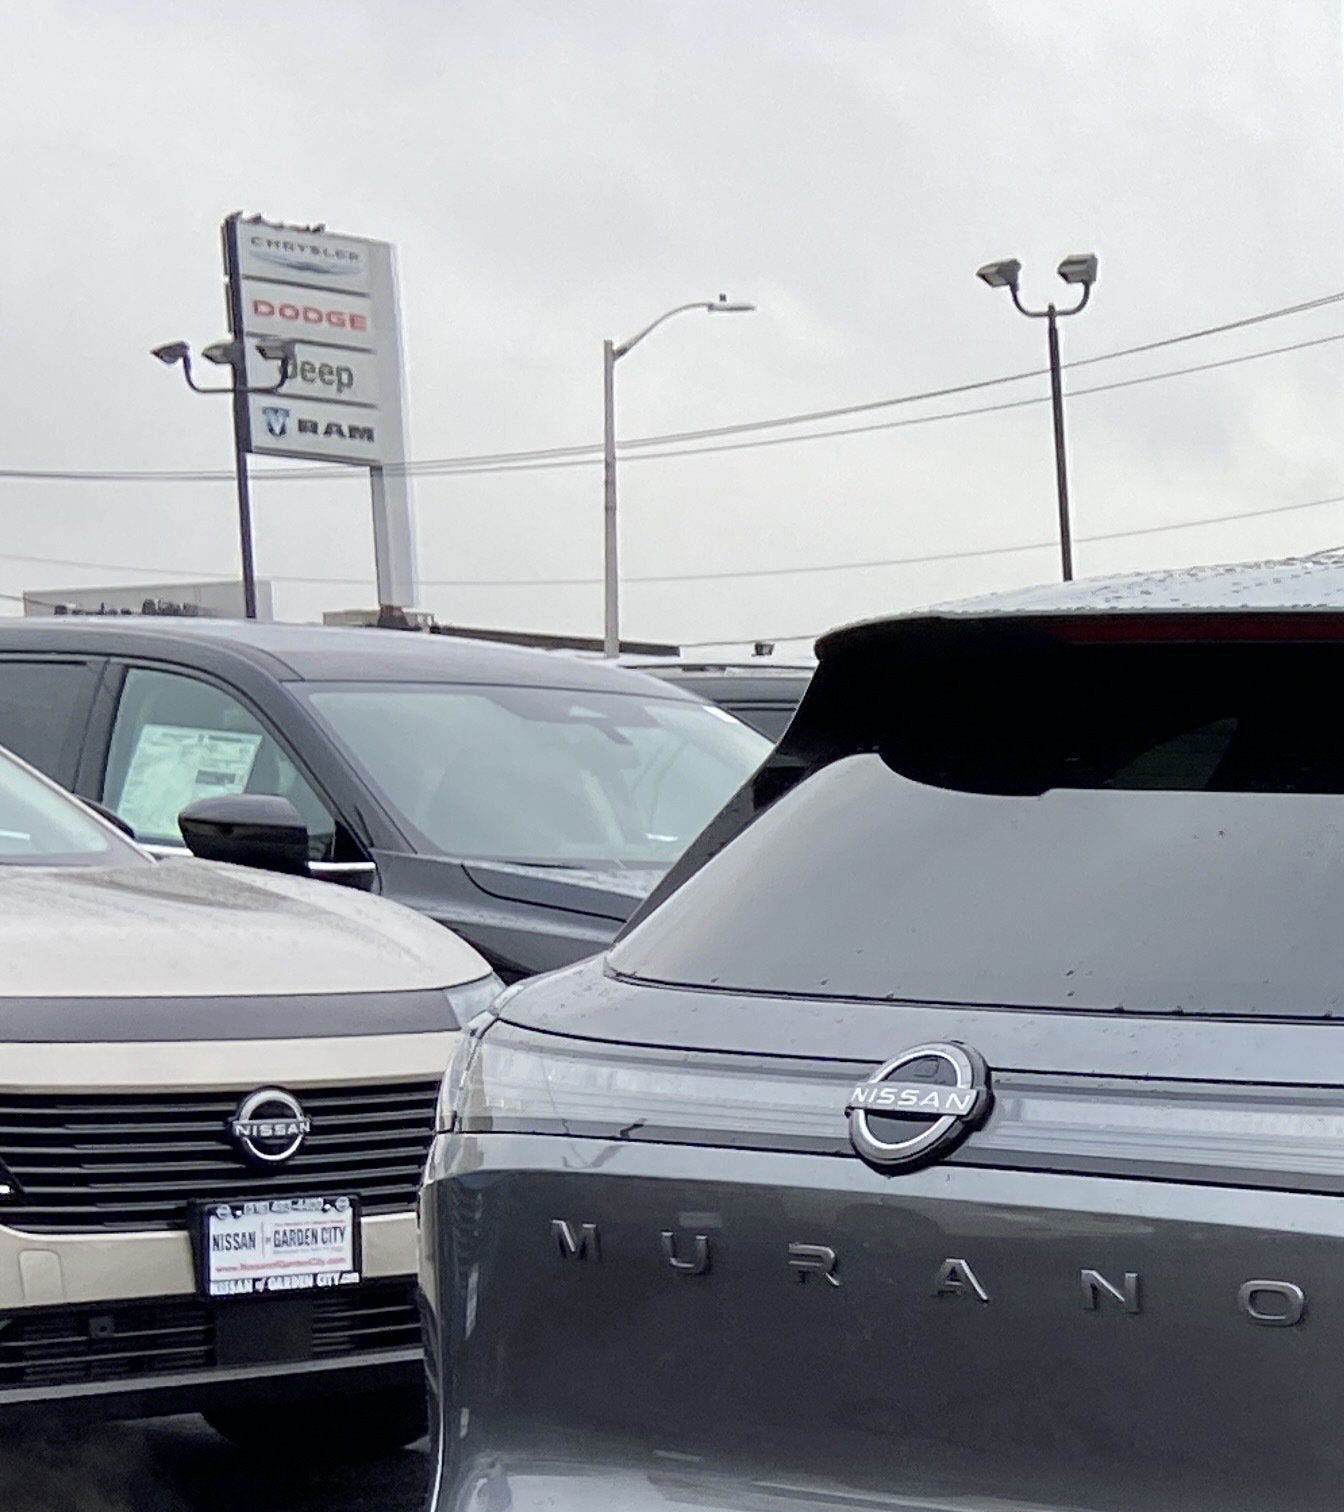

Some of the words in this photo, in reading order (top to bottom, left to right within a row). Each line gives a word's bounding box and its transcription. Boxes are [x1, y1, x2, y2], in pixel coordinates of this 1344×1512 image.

[250, 236, 360, 261] CHRYSLER
[253, 299, 367, 332] DODGE
[279, 357, 354, 392] Jeep
[297, 418, 376, 442] RAM
[850, 1087, 972, 1111] NISSAN
[234, 1120, 311, 1137] NISSAN
[212, 1231, 256, 1251] NISSAN
[273, 1228, 318, 1248] GARDEN
[321, 1226, 347, 1244] CITY
[550, 1218, 1305, 1327] MURANO
